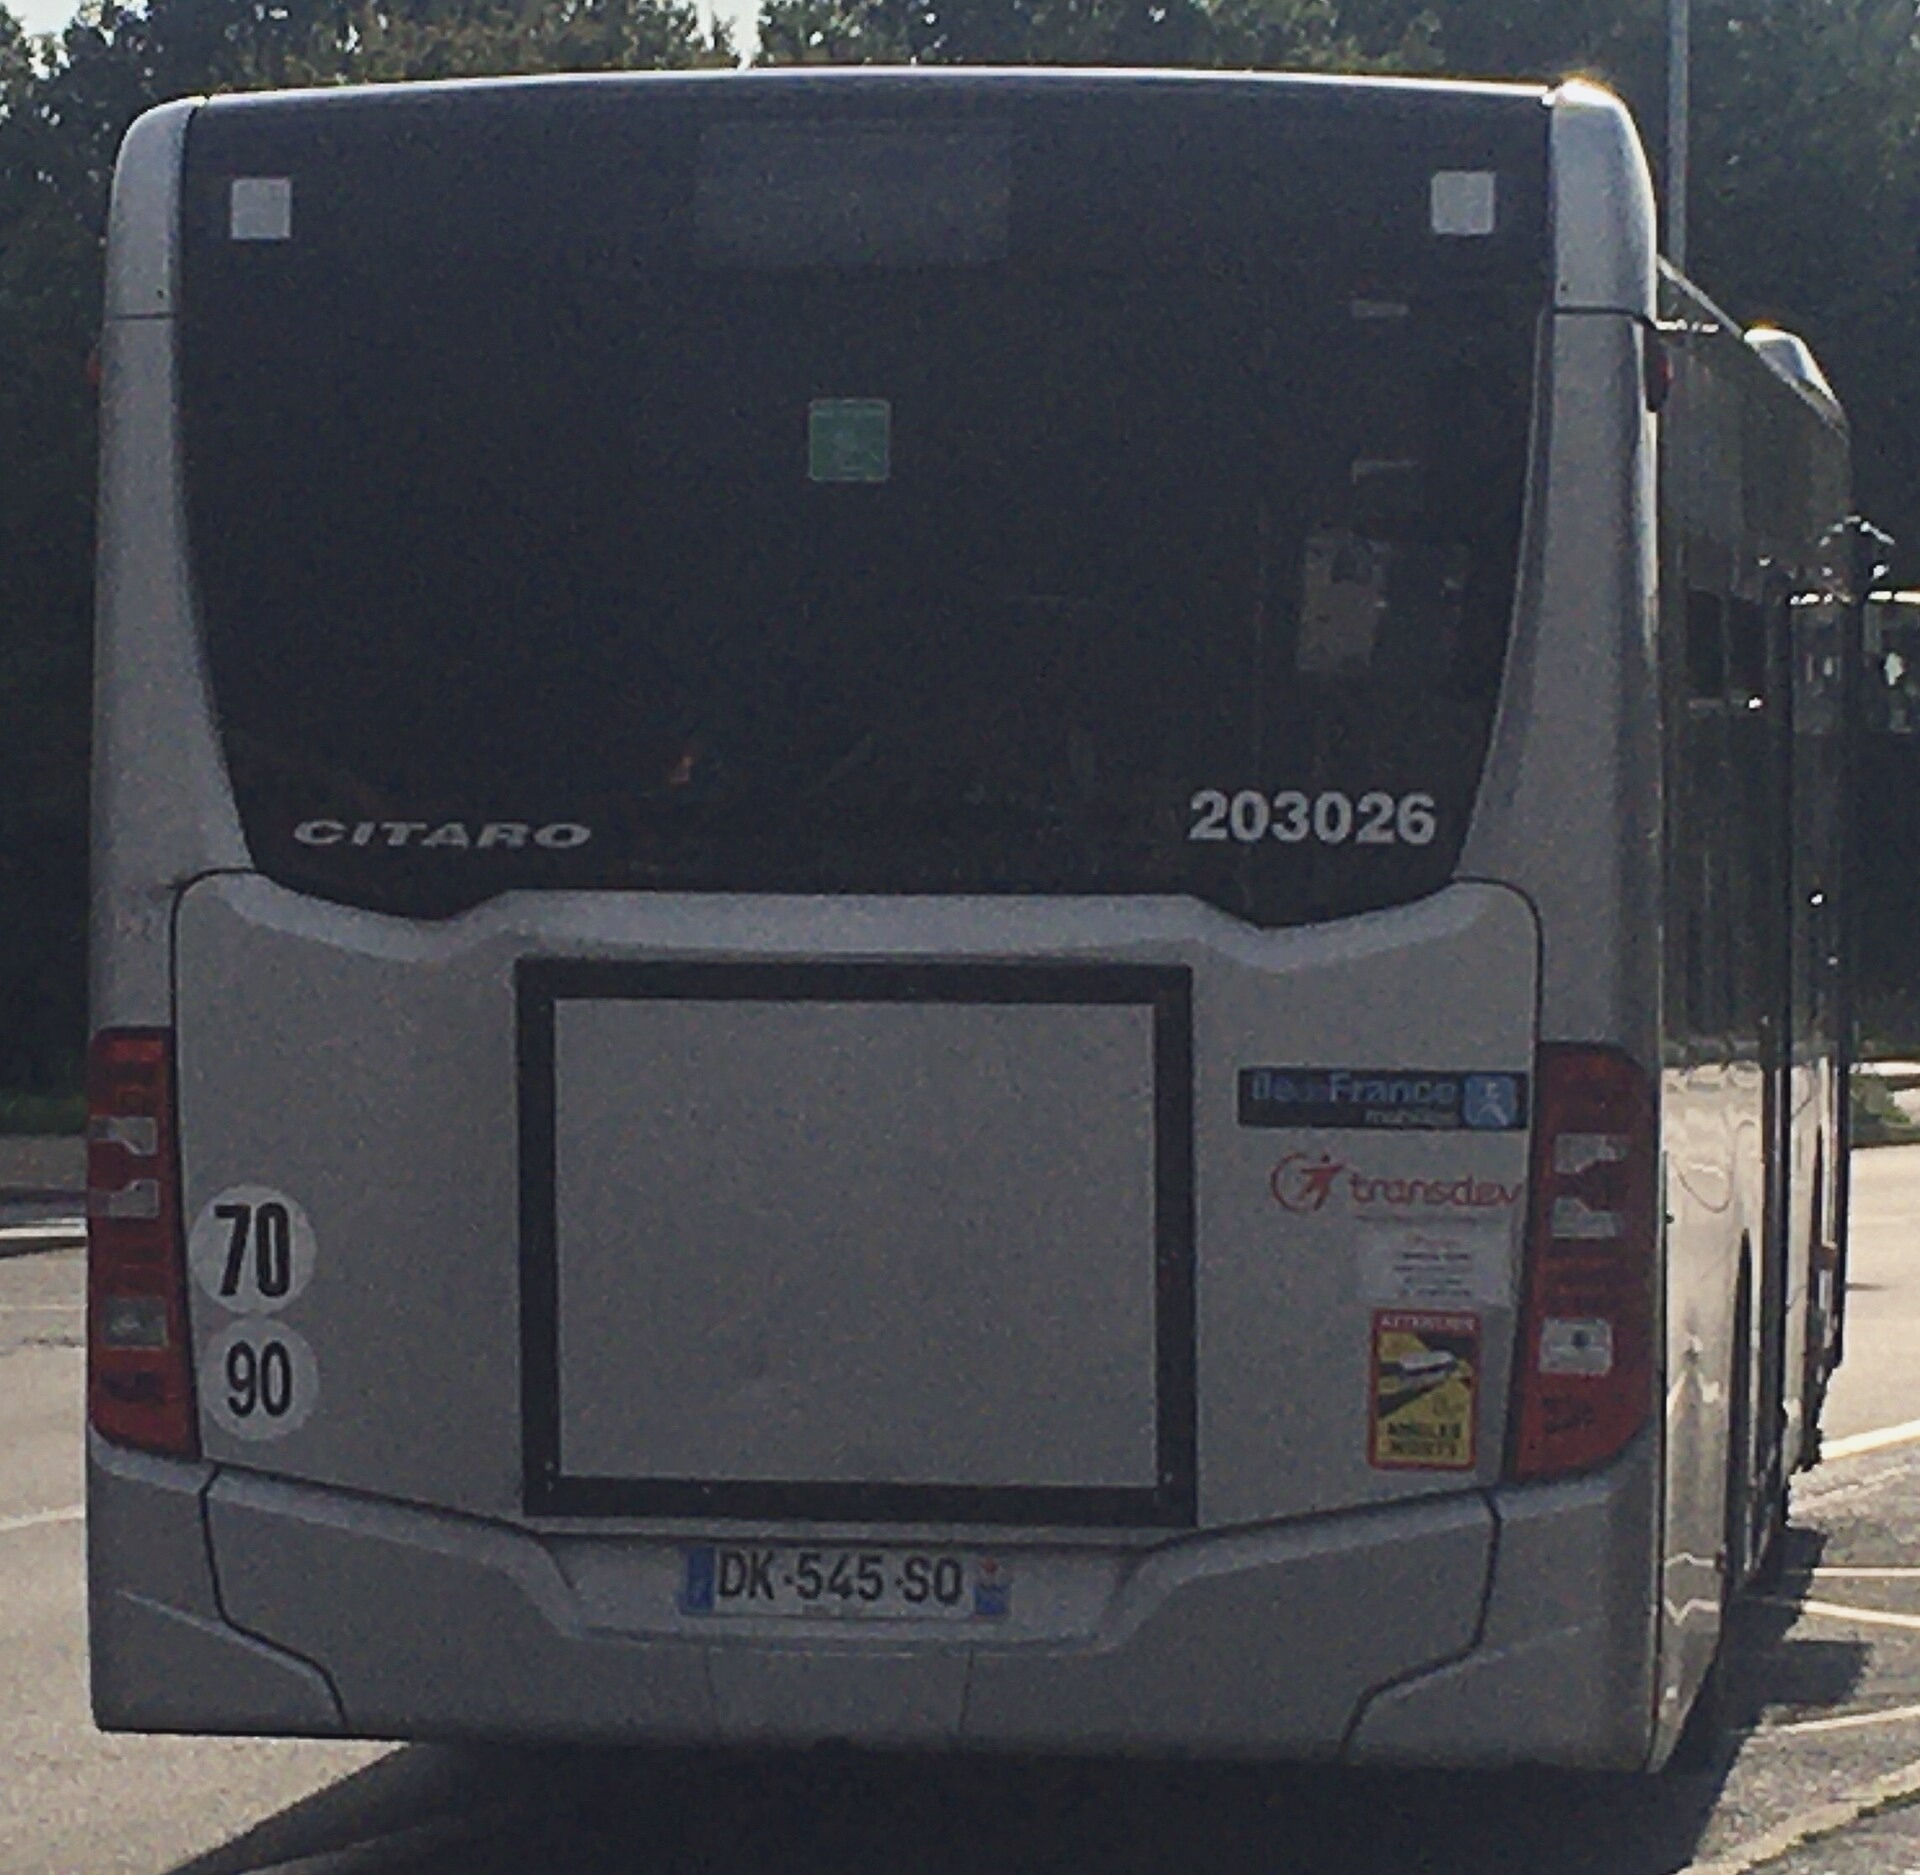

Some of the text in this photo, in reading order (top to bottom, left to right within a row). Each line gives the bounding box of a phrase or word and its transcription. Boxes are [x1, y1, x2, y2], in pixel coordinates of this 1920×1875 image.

[293, 818, 592, 849] CITARO
[1187, 789, 1437, 845] 203026
[1348, 1172, 1524, 1207] transdev
[213, 1202, 291, 1298] 70
[226, 1339, 292, 1418] 90
